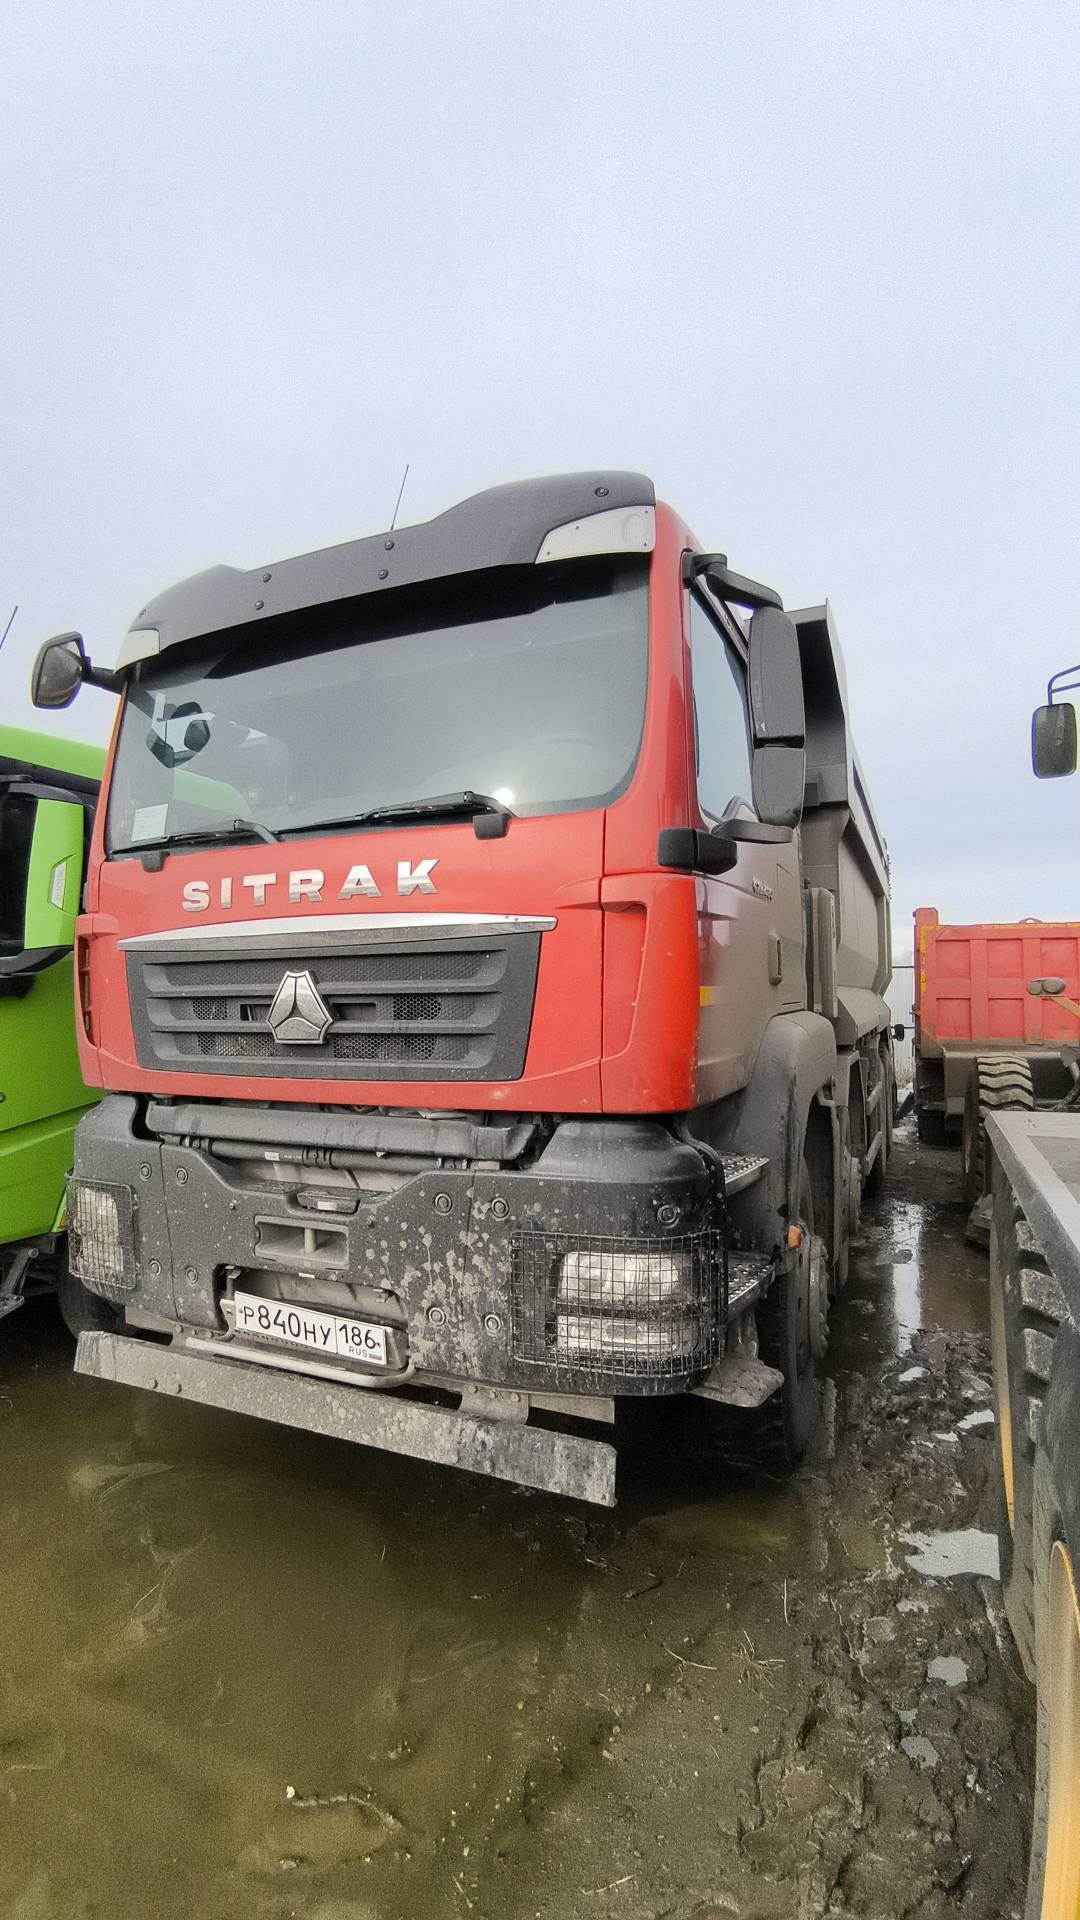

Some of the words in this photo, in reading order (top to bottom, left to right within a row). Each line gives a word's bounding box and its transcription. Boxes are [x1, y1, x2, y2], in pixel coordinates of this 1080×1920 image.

[181, 859, 440, 912] SITRAK
[338, 1323, 377, 1350] 186
[348, 1345, 368, 1358] RUS
